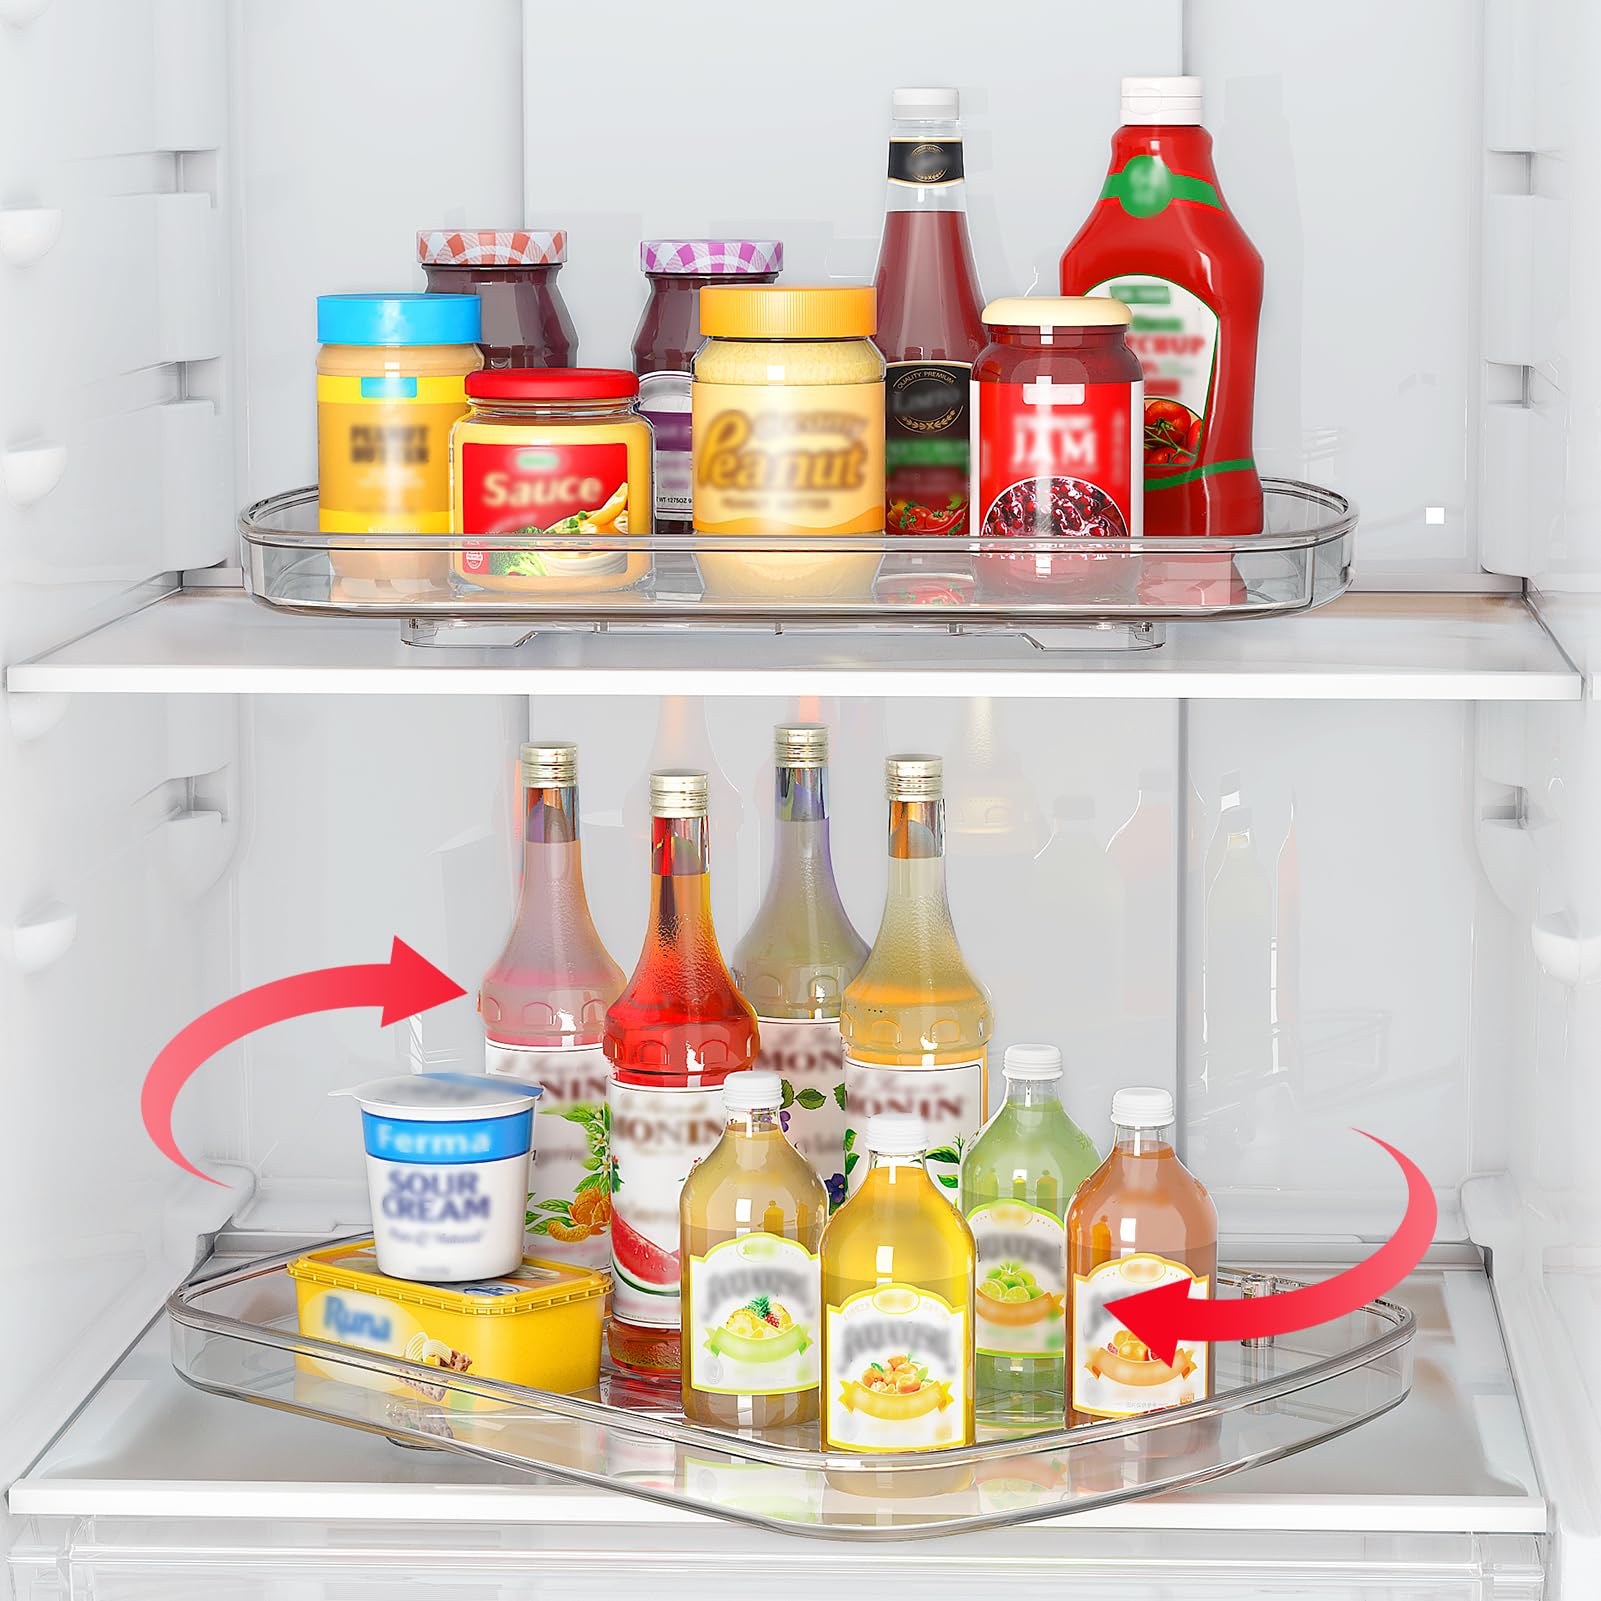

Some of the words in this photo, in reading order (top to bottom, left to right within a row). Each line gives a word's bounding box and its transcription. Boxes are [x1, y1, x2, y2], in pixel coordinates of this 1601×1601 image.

[897, 372, 922, 389] QUALITY
[923, 371, 955, 384] PREMIUM
[482, 471, 603, 508] Sauce
[376, 1122, 491, 1154] Ferma
[387, 1169, 480, 1196] SOUR
[382, 1194, 492, 1221] CREAM
